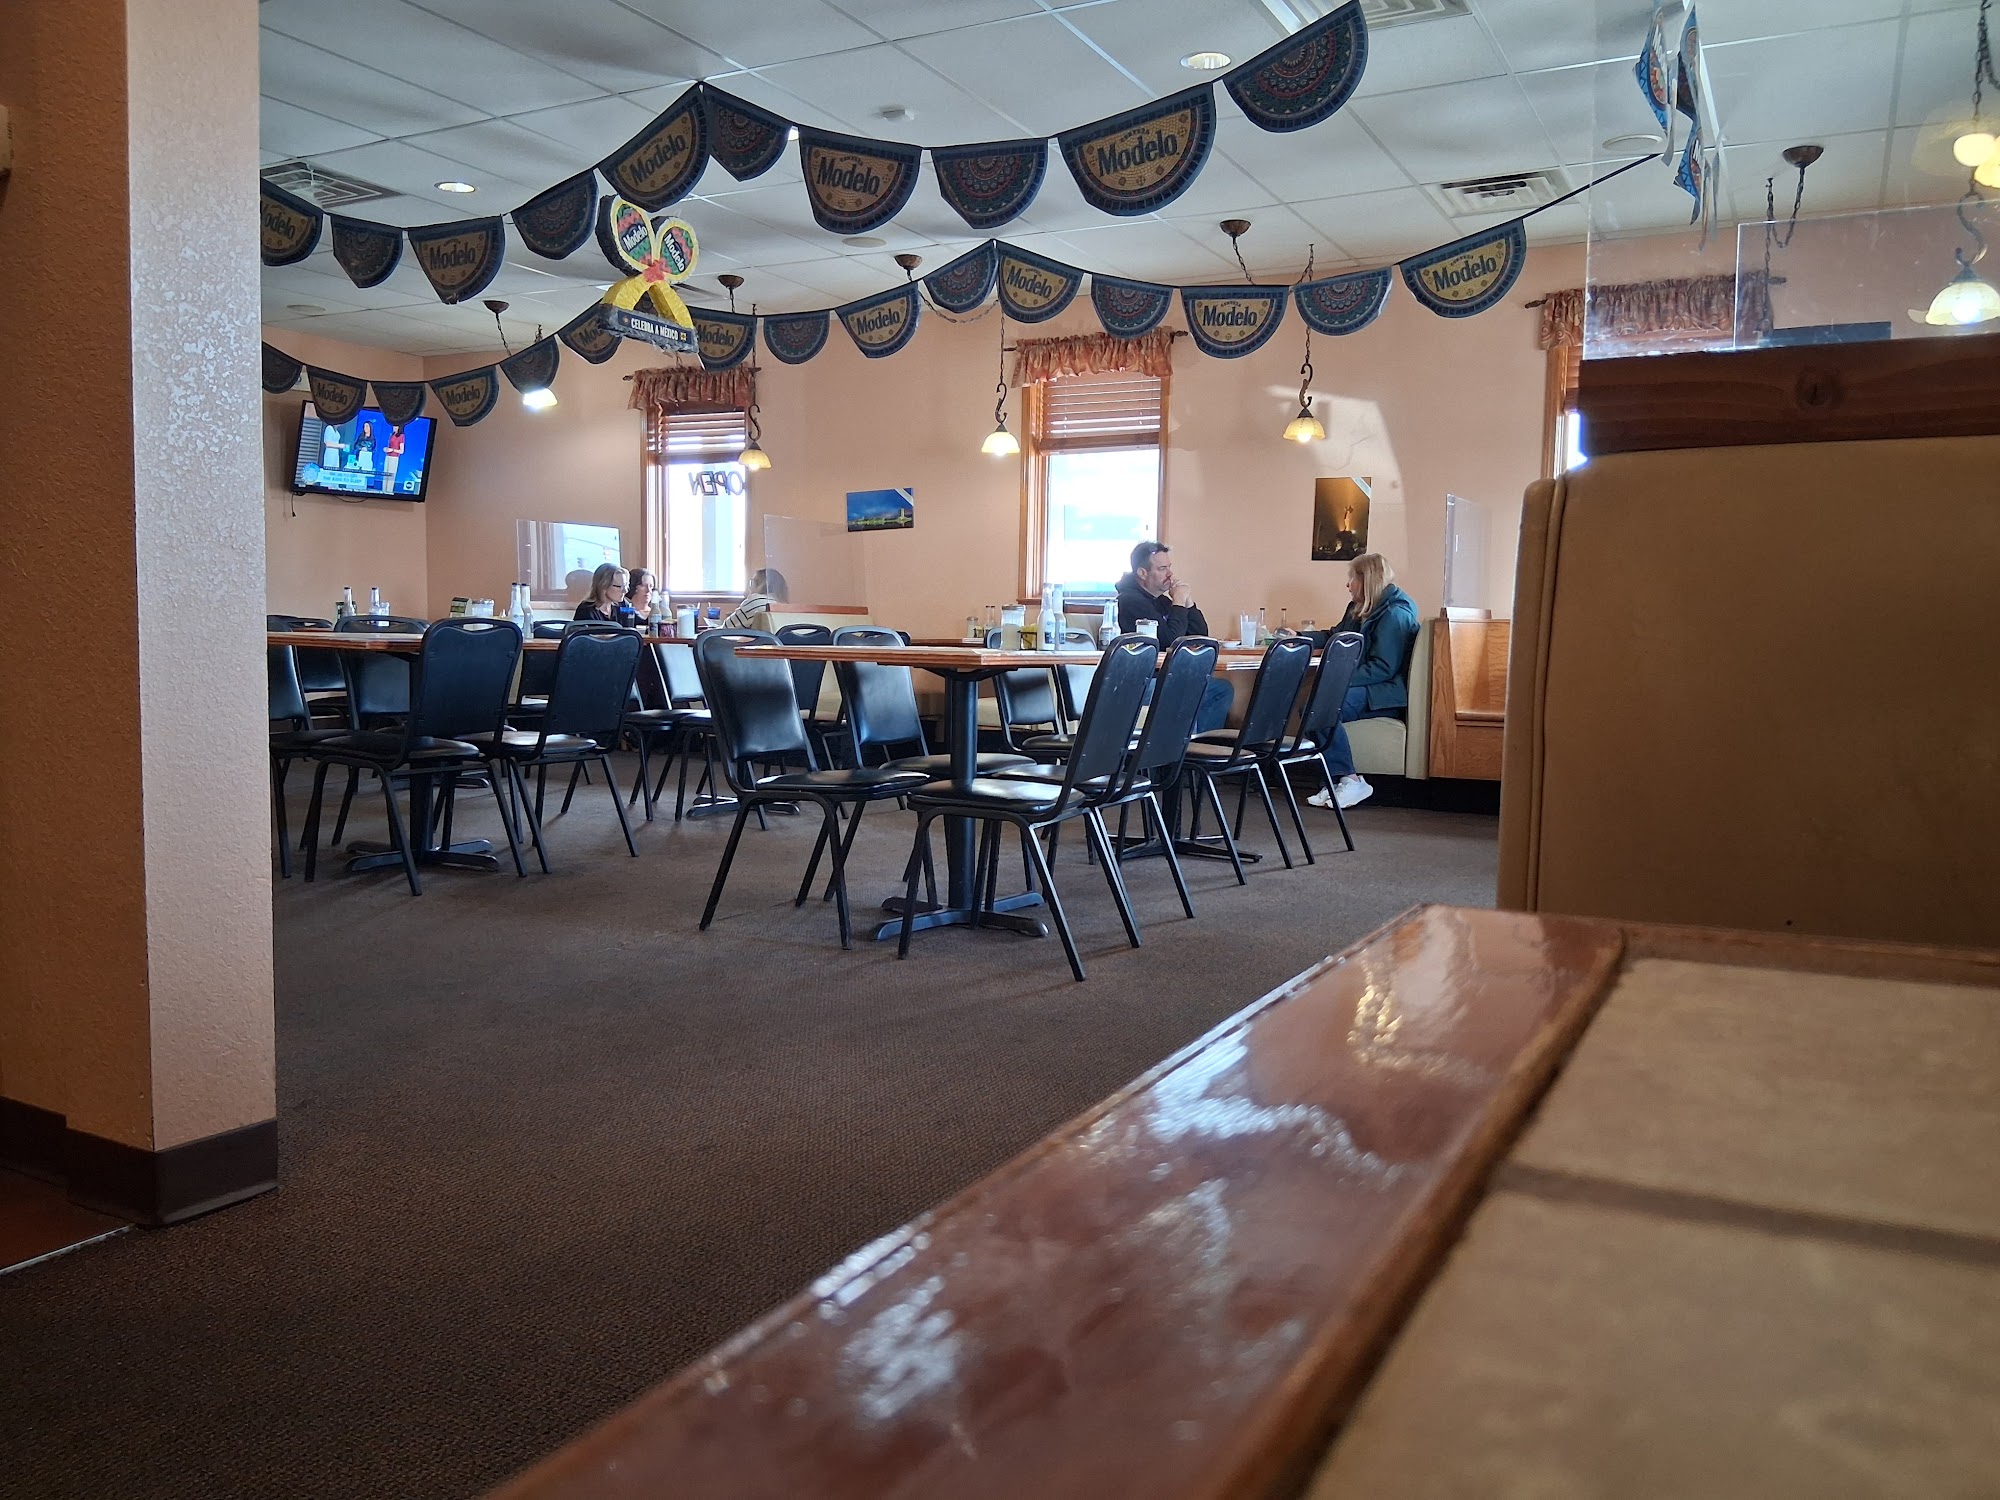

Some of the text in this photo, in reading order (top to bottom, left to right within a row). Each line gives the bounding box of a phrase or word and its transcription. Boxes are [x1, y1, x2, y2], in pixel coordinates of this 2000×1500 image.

[629, 134, 686, 187] Modelo
[1097, 130, 1178, 177] Modelo
[818, 157, 880, 195] Modelo
[261, 206, 295, 239] odelo
[623, 225, 648, 250] Modelo
[430, 242, 475, 270] Modelo
[664, 233, 685, 271] Modelo
[1006, 265, 1053, 299] Modelo
[1432, 255, 1497, 291] Modelo
[856, 307, 900, 335] Modelo
[1203, 305, 1257, 326] Modelo
[698, 324, 735, 346] Modelo
[316, 382, 348, 405] Modelo
[446, 385, 480, 406] Modelo
